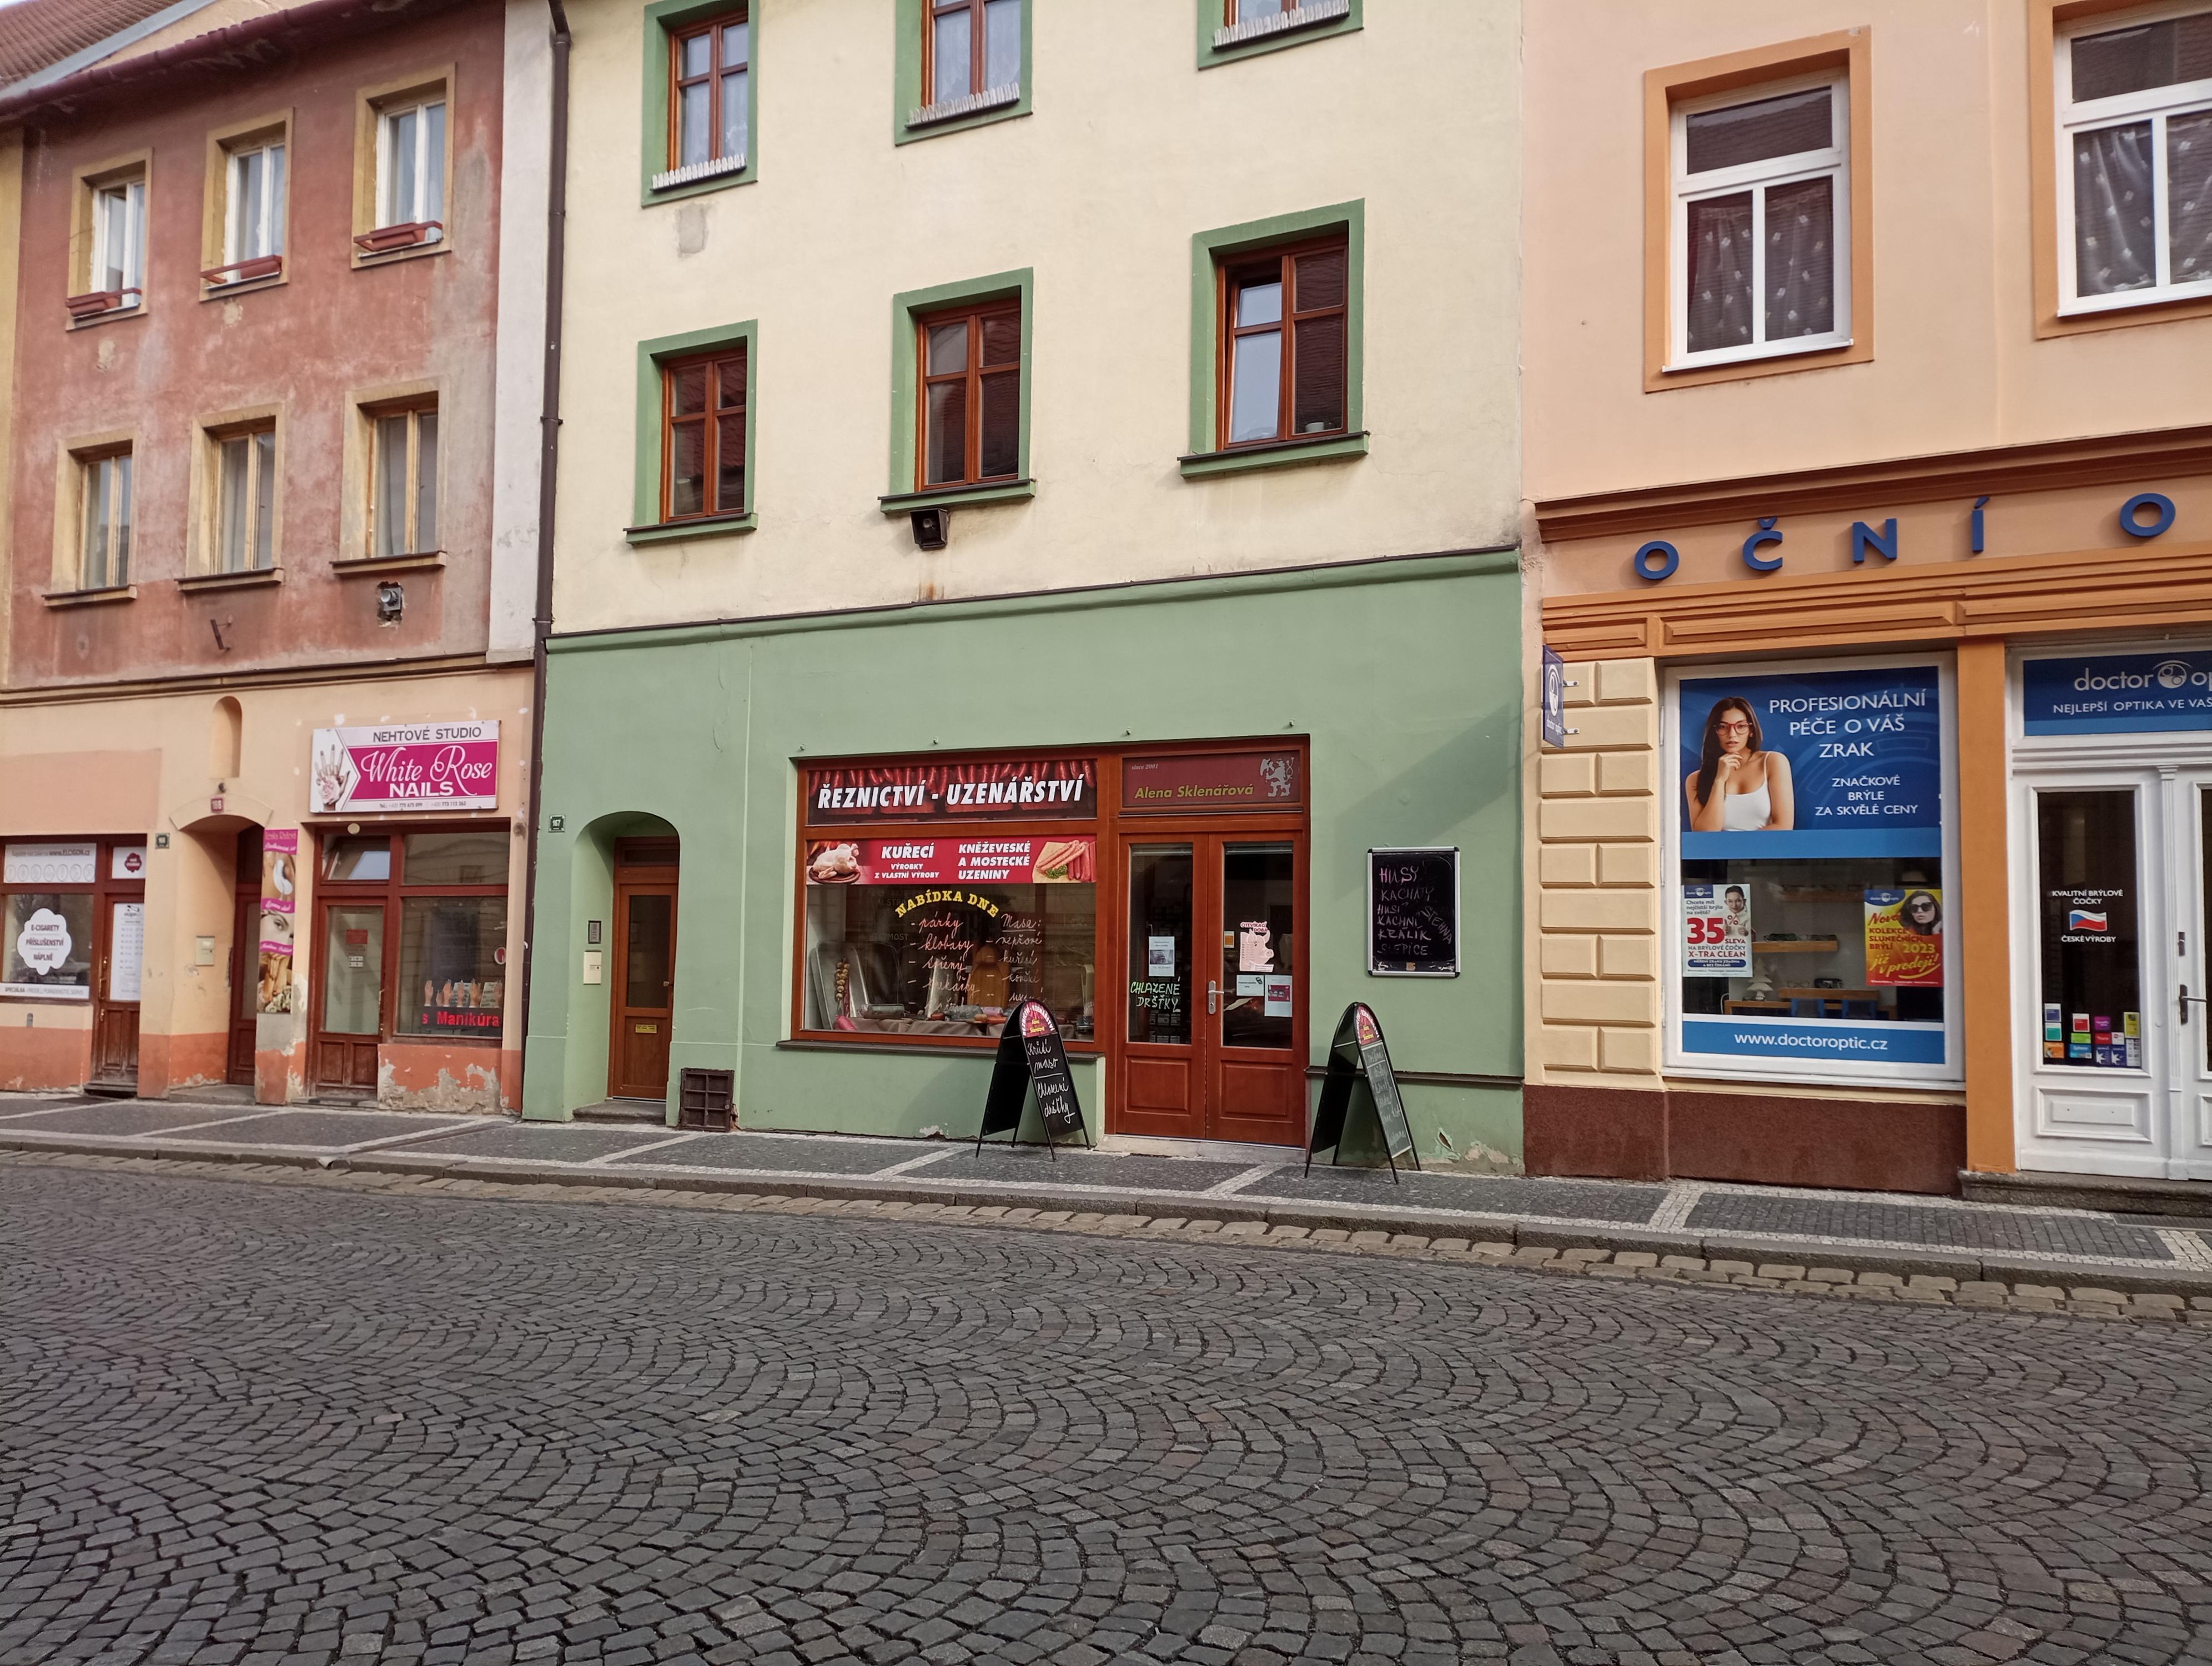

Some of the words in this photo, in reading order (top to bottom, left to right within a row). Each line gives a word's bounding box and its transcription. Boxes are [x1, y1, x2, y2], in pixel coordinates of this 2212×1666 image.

[1634, 495, 1990, 580] OČNÍ
[2074, 668, 2154, 691] doctor
[1769, 688, 1927, 714] PROFESIONÁLNÍ
[2053, 701, 2107, 715] NEJLEPŠÍ
[2114, 701, 2164, 711] OPTIKA
[2168, 699, 2184, 708] VE
[1790, 717, 1836, 736] PÉČE
[1844, 719, 1862, 734] O
[1867, 714, 1905, 732] VÁŠ
[373, 726, 430, 742] NEHTOVÉ
[435, 727, 482, 739] STUDIO
[1819, 742, 1874, 758] ZRAK
[361, 747, 423, 782] White
[430, 745, 492, 796] Rose
[1832, 774, 1900, 787] ZNAČKOVÉ
[390, 781, 454, 797] NAILS
[818, 780, 926, 809] ŘEZNICTVÍ
[946, 774, 1084, 805] UZENÁŘSTVÍ
[1134, 786, 1172, 799] Alena
[1177, 783, 1253, 797] Sklenářová
[1848, 790, 1884, 800] BRÝLE
[1815, 806, 1833, 816] ZA
[1837, 804, 1879, 815] SKVĚLÉ
[1883, 805, 1918, 814] CENY
[881, 842, 934, 859] KUŘECÍ
[958, 841, 1031, 854] KNĚŽEVESKÉ
[958, 857, 966, 866] A
[970, 854, 1030, 866] MOSTECKÉ
[958, 870, 1010, 880] UZENINY
[1379, 866, 1419, 884] HUSY
[894, 889, 963, 918] NABÍDKA
[967, 893, 1000, 917] DNE
[918, 911, 963, 937] párky
[1687, 917, 1725, 944] 35
[26, 937, 64, 946] PŘÍSLUŠENSTVÍ
[1903, 944, 1936, 953] 2023
[1130, 976, 1180, 995] CHLAZENÉ
[1136, 995, 1181, 1012] DRŠŤKY
[436, 1011, 500, 1027] Manikúra
[1734, 1033, 1888, 1051] www.doctoroptic.cz
[1034, 1058, 1058, 1074] maso
